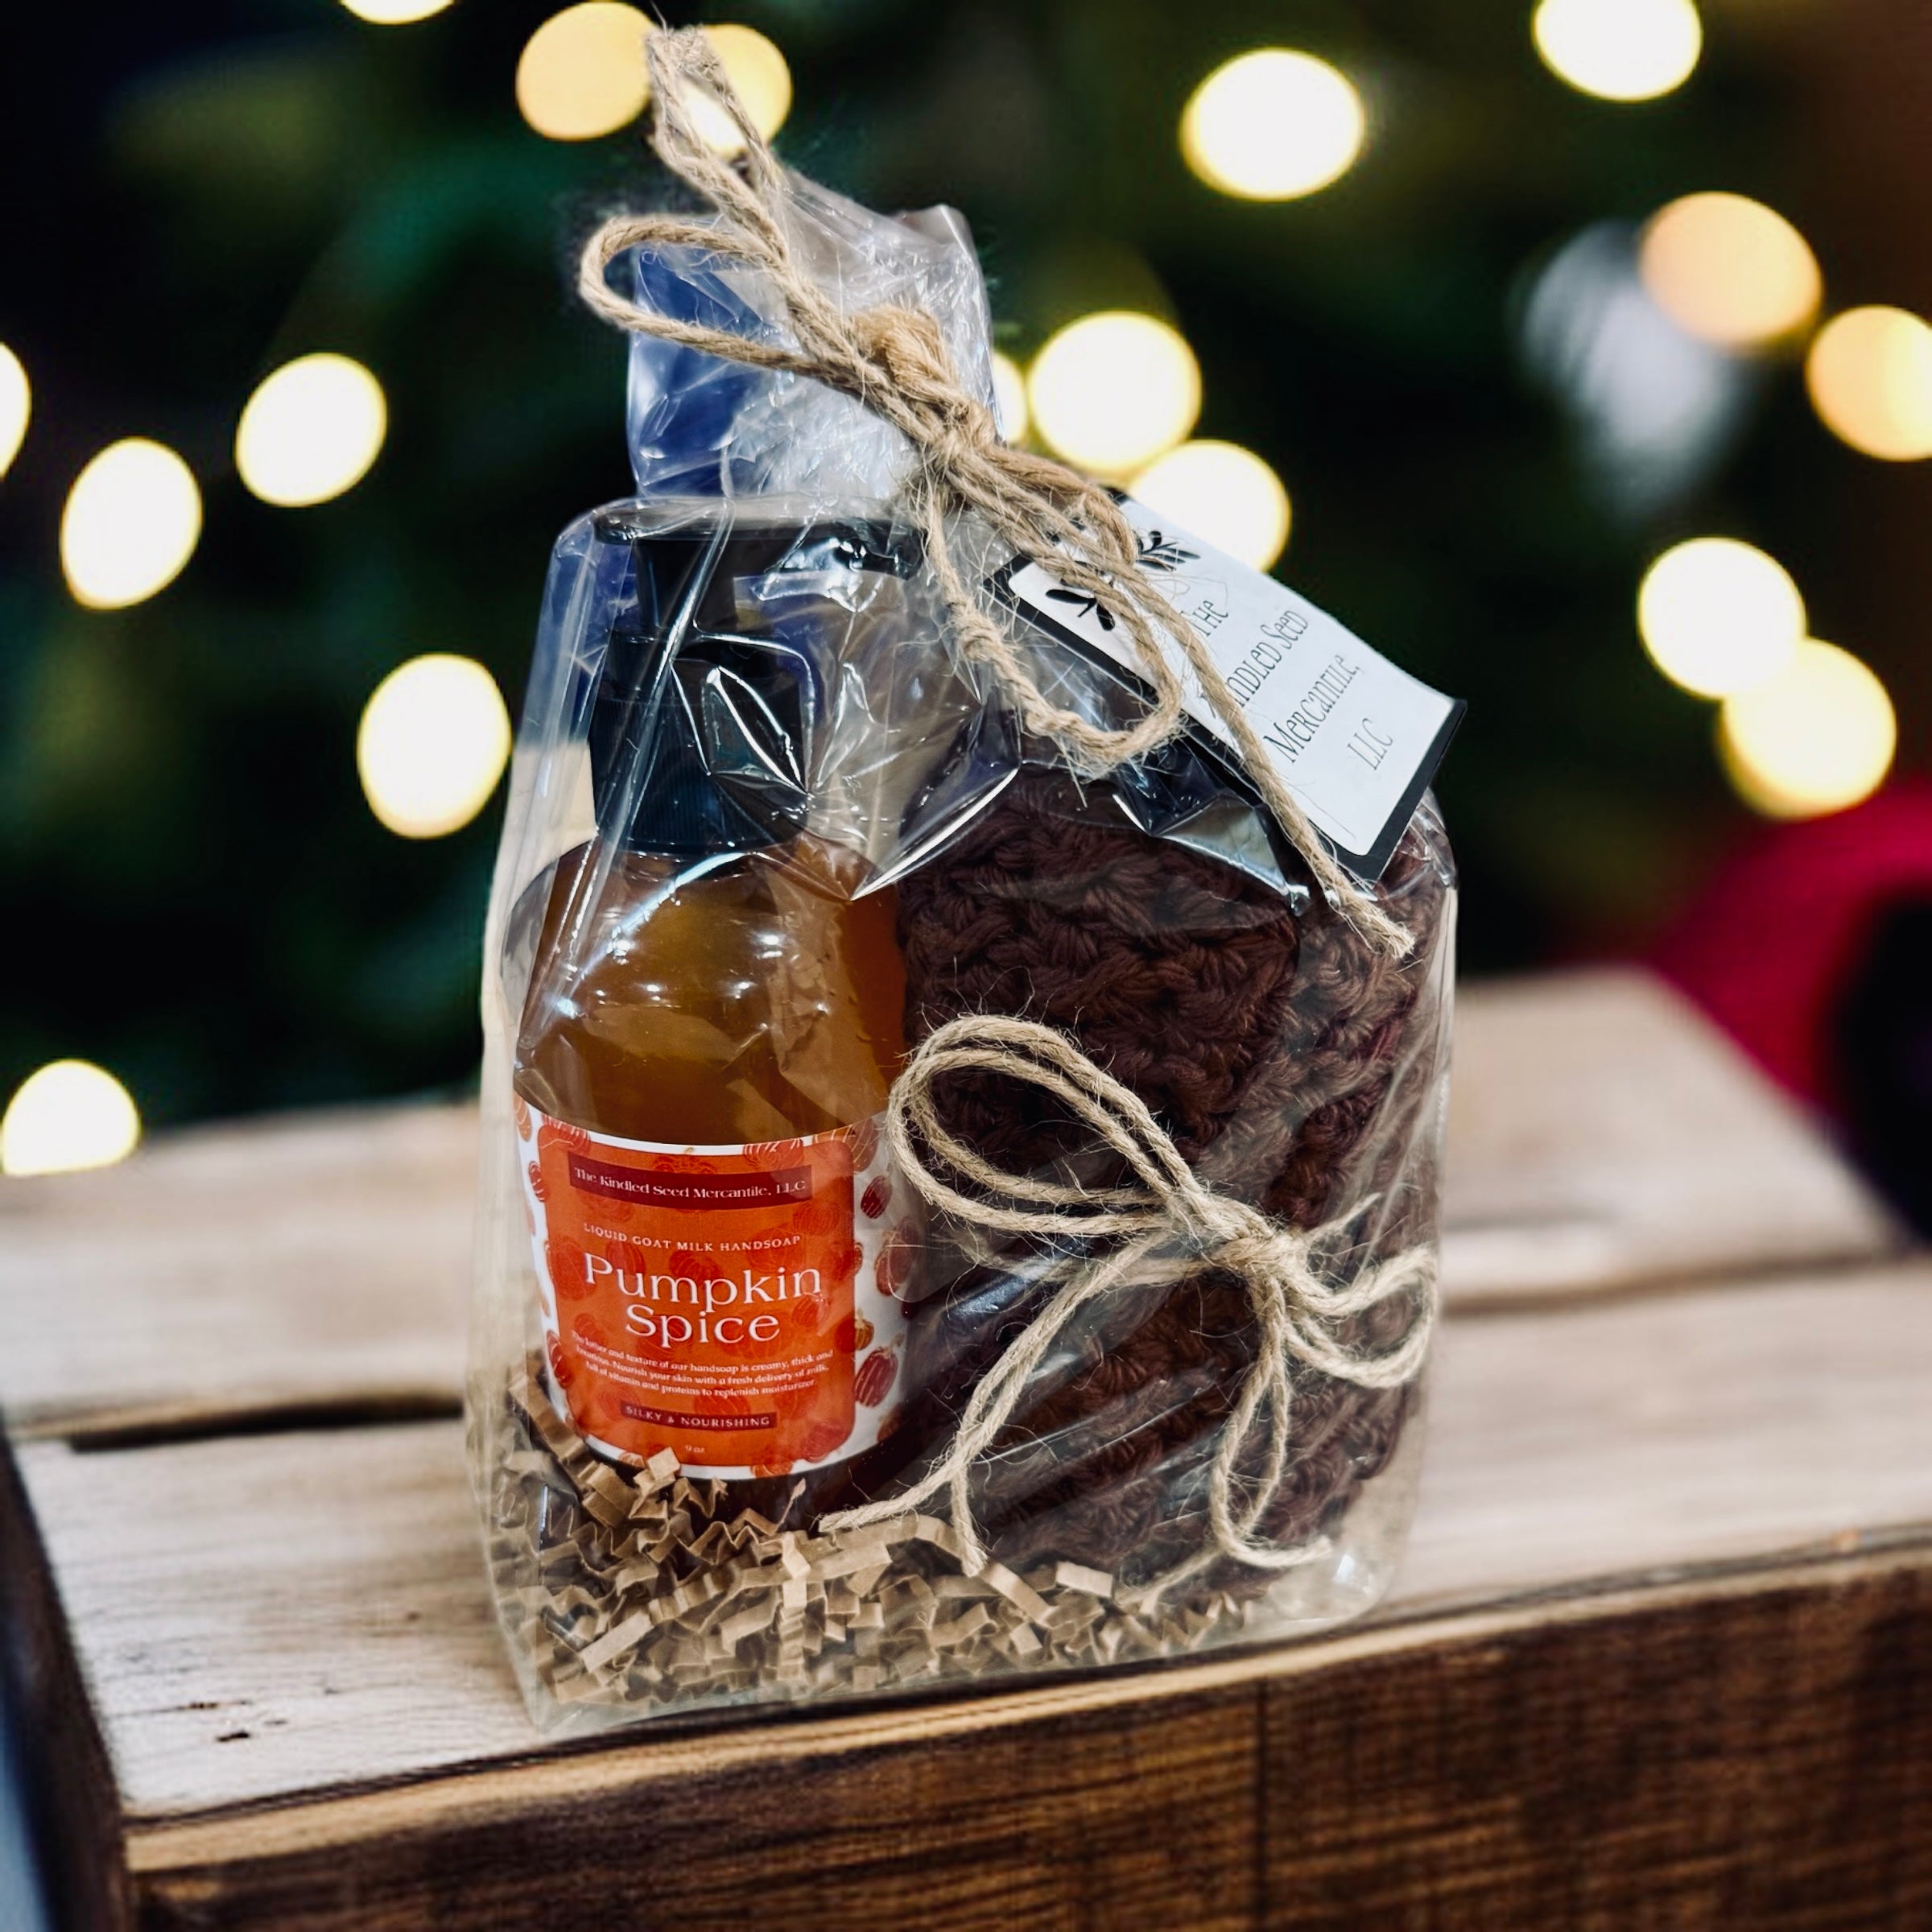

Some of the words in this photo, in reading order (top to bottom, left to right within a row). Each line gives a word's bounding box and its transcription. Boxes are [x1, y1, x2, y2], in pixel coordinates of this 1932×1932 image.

[1260, 610, 1309, 650] Seed
[1347, 717, 1393, 770] LLC
[574, 1167, 597, 1183] The
[601, 1175, 650, 1194] Kindled
[653, 1185, 689, 1198] Seed
[776, 1180, 806, 1195] LLC
[584, 1223, 627, 1241] LIQUID
[632, 1235, 671, 1249] GOAT
[677, 1241, 713, 1252] MILK
[720, 1235, 800, 1252] HANDSOAP
[584, 1252, 821, 1313] Pumpkin
[625, 1303, 781, 1348] Spice
[608, 1348, 625, 1360] and
[626, 1354, 658, 1367] texture
[659, 1360, 670, 1369] of
[691, 1364, 739, 1376] handsoap
[741, 1364, 749, 1372] is
[791, 1354, 815, 1366] thick
[816, 1349, 834, 1361] and
[613, 1360, 648, 1377] Nourish
[650, 1371, 671, 1381] your
[672, 1373, 692, 1382] skin
[695, 1375, 716, 1385] with
[728, 1375, 753, 1385] fresh
[754, 1372, 793, 1384] delivery
[795, 1369, 804, 1377] of
[609, 1371, 641, 1386] vitamin
[642, 1381, 659, 1391] and
[661, 1384, 700, 1396] proteins
[702, 1387, 712, 1396] to
[714, 1387, 759, 1399] replenish
[625, 1406, 662, 1421] SILKY
[667, 1416, 675, 1424] &
[681, 1416, 770, 1428] NOURISHING
